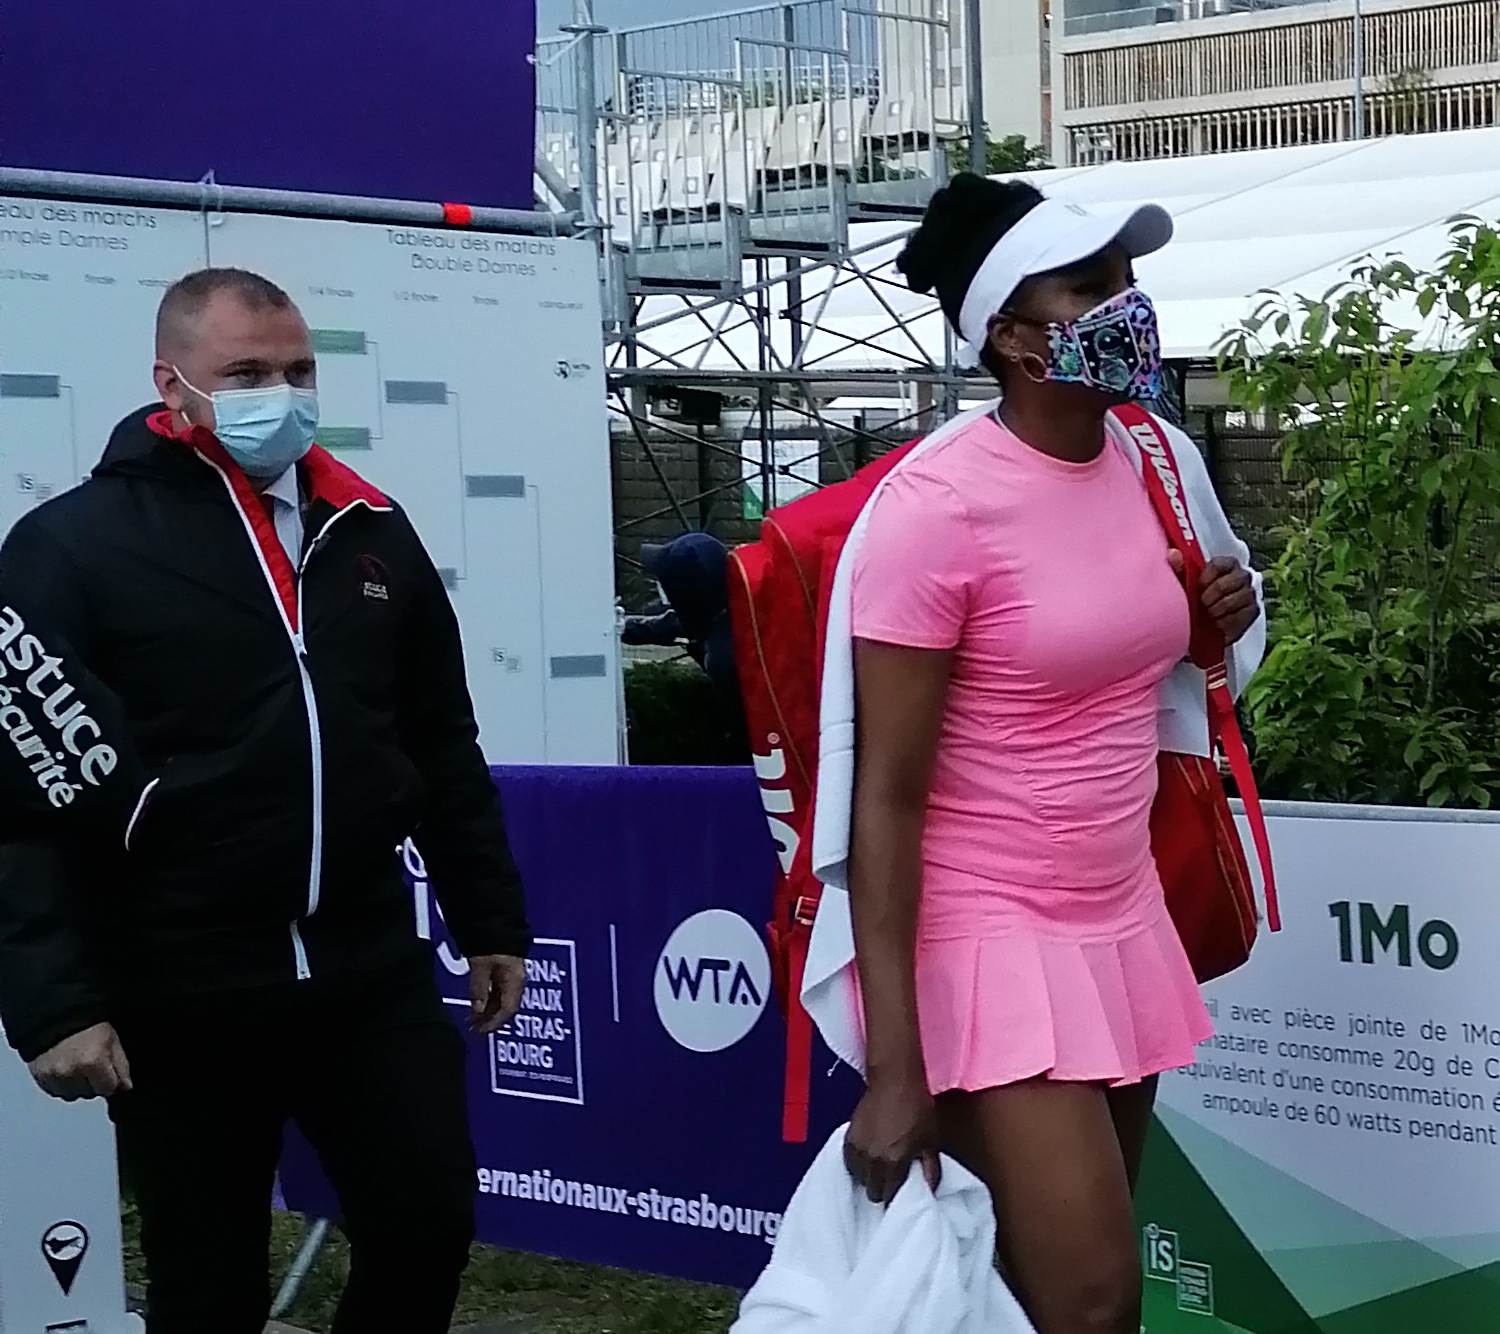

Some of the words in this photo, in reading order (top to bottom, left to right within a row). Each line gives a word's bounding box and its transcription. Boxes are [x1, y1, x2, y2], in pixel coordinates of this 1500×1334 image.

[40, 203, 77, 222] des
[83, 208, 157, 228] matchs
[58, 229, 129, 250] Dames
[387, 229, 455, 249] Tableau
[460, 233, 490, 251] des
[494, 240, 557, 256] matchs
[411, 253, 473, 272] Double
[477, 258, 537, 276] Dames
[0, 606, 118, 786] astuce
[1328, 900, 1460, 971] 1Mo
[664, 955, 762, 1007] WTA
[514, 1013, 571, 1041] STRAS-
[1230, 1005, 1272, 1024] avec
[1284, 1007, 1336, 1031] pièce
[1348, 1012, 1407, 1039] jointe
[1420, 1019, 1448, 1042] de
[497, 1039, 554, 1068] BOURG
[1277, 1040, 1385, 1068] consomme
[1392, 1049, 1436, 1077] 20g
[1446, 1054, 1474, 1076] de
[1272, 1068, 1326, 1093] d'une
[1330, 1077, 1486, 1112] consommation
[1202, 1092, 1280, 1119] ampoule
[1284, 1101, 1310, 1123] de
[1314, 1103, 1342, 1126] 60
[1346, 1110, 1403, 1135] watts
[1407, 1118, 1498, 1145] pendant
